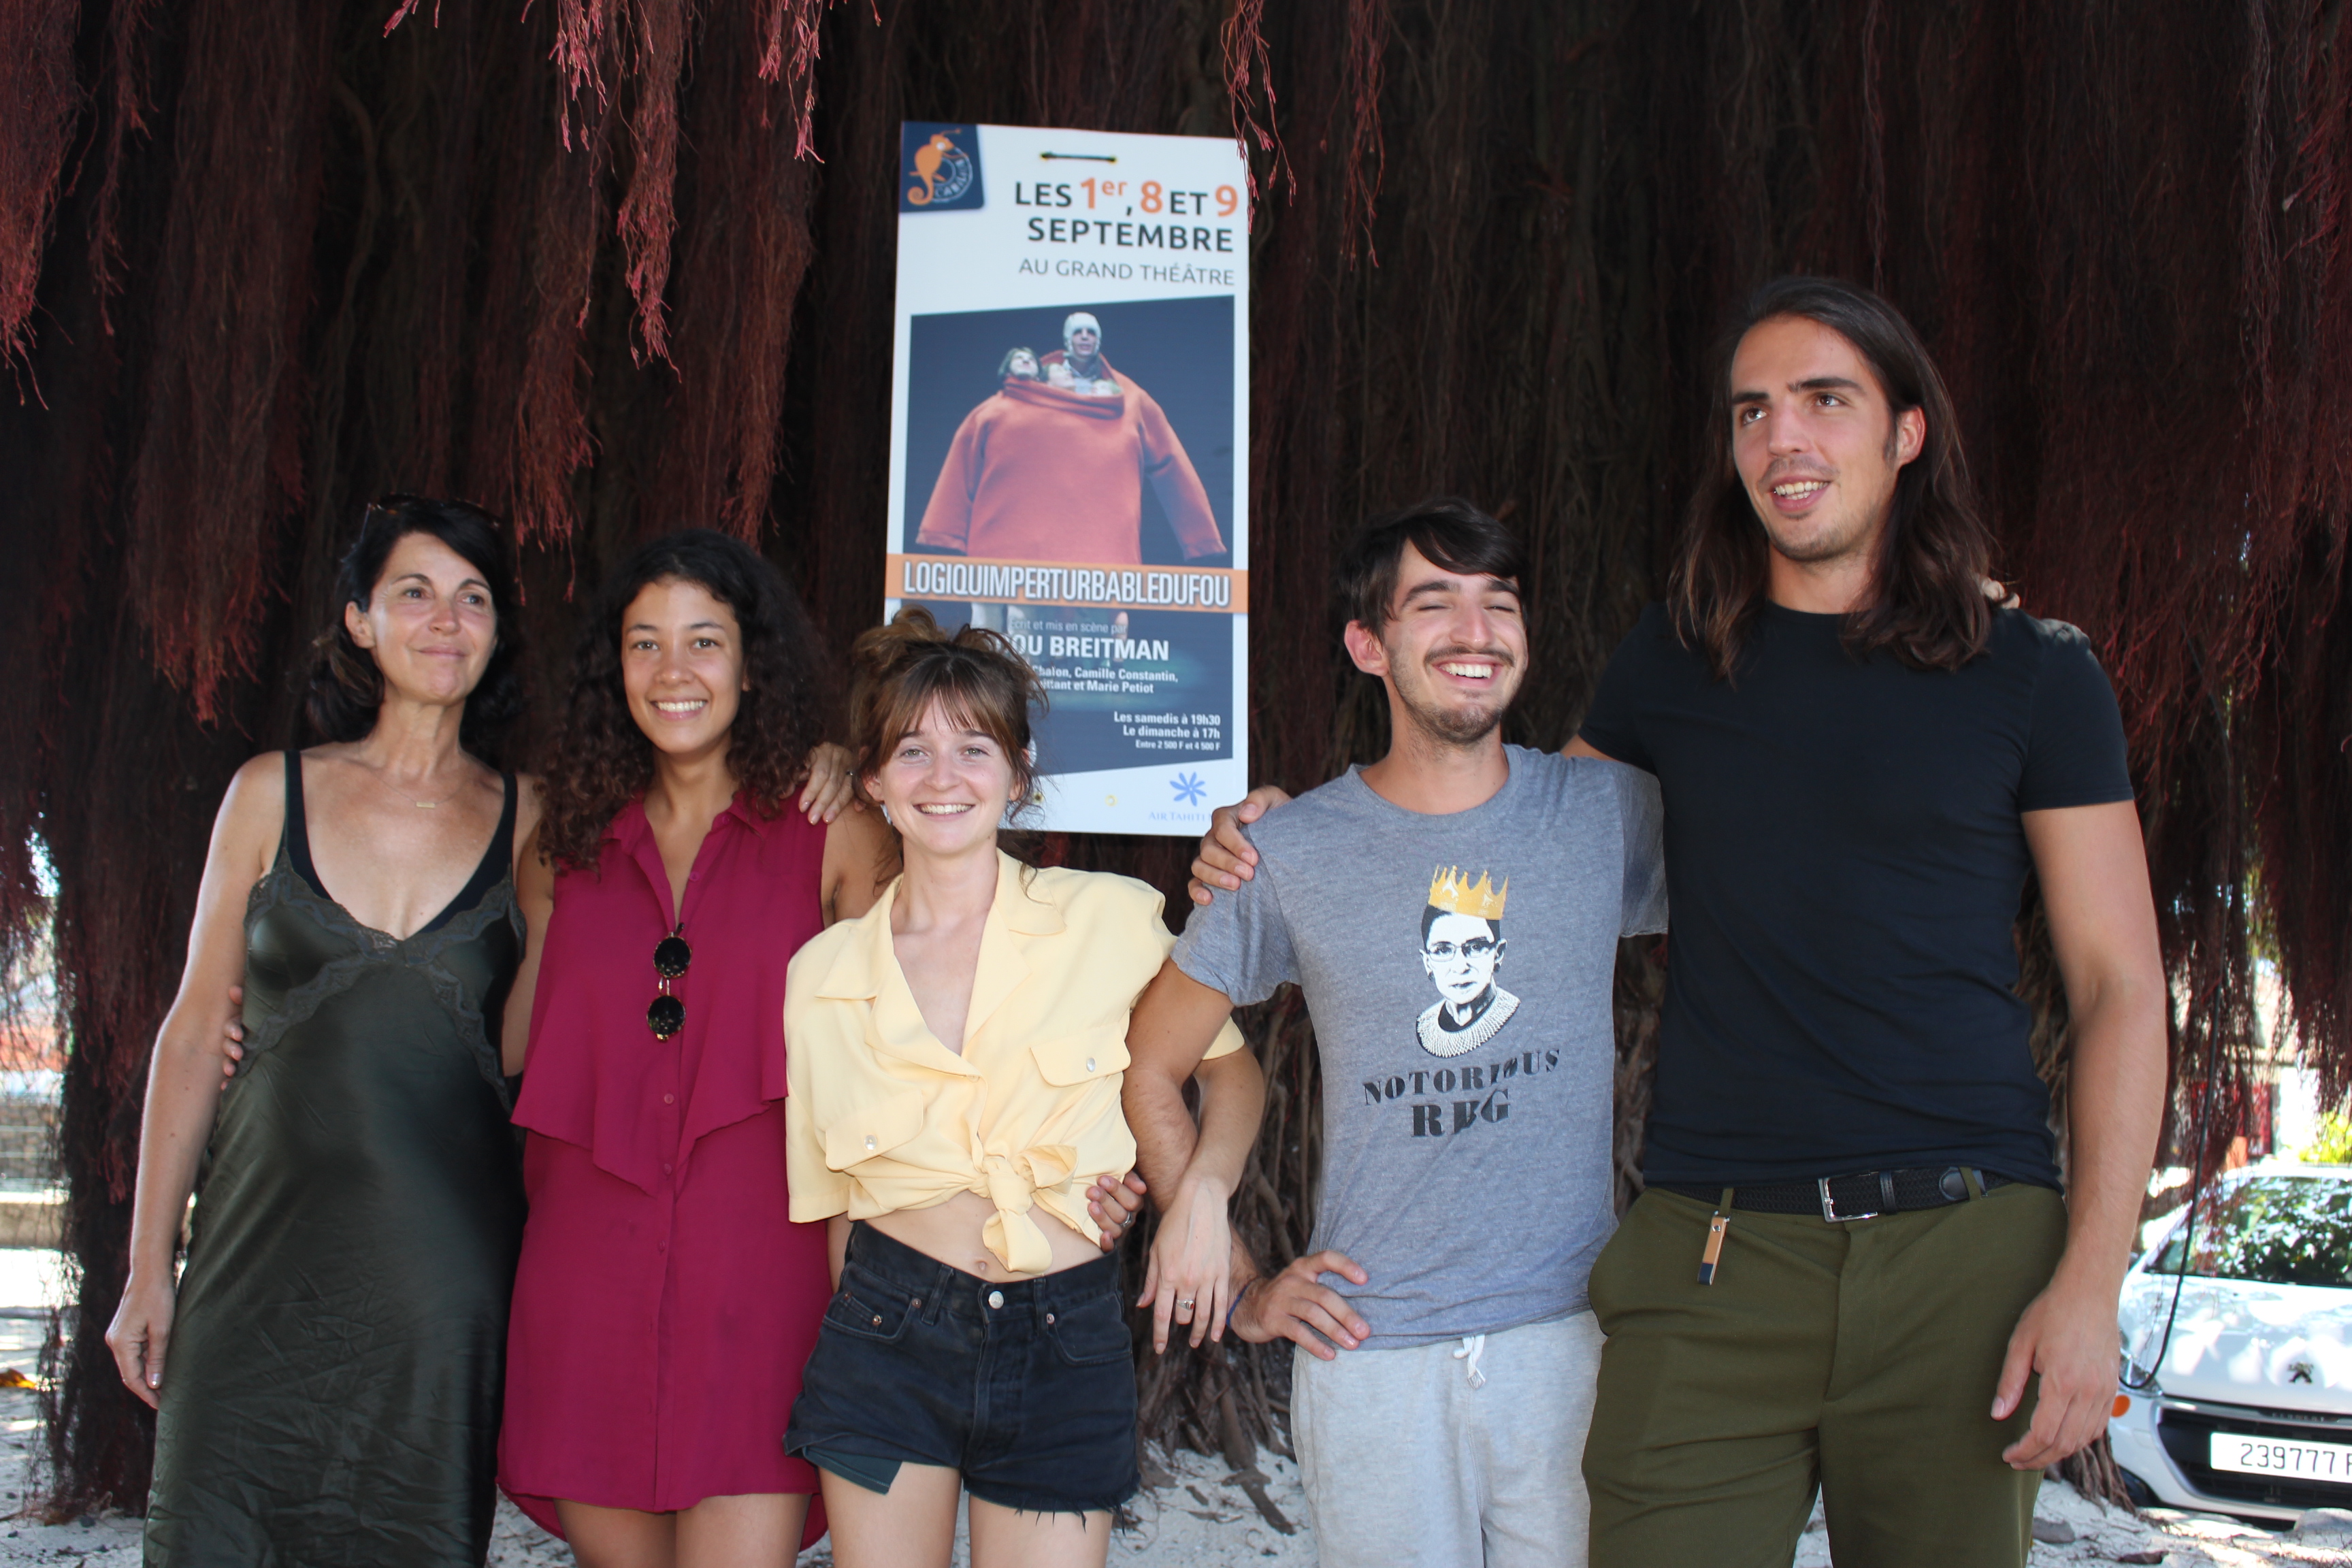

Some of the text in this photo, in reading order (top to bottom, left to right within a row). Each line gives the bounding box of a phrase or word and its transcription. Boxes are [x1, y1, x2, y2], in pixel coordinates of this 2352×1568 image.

[1015, 182, 1072, 207] LES
[1140, 180, 1164, 214] 8
[1170, 191, 1208, 215] ET
[1215, 184, 1239, 217] 9
[1028, 217, 1234, 252] SEPTEMBRE
[1018, 259, 1235, 286] AU GRAND THÉÂTRE
[904, 561, 1229, 606] LOGIQUIMPERTURBABLEDUFOU
[1032, 620, 1044, 631] et
[1045, 621, 1064, 632] mis
[1065, 623, 1078, 632] en
[1080, 621, 1109, 634] scène
[1111, 624, 1128, 636] par
[1049, 636, 1169, 662] BREITMAN
[1073, 681, 1085, 691] et
[1086, 681, 1120, 693] Marie
[1122, 681, 1155, 694] Petiot
[1074, 666, 1115, 680] Camille
[1118, 668, 1179, 683] Constantin,
[1113, 710, 1221, 726] Les samedis à 19h30
[1123, 724, 1221, 739] Le dimanche à 17h
[1135, 739, 1156, 749] Entre
[1157, 740, 1162, 749] 2
[1186, 742, 1193, 750] et
[1362, 1049, 1561, 1106] NOTORIOUS
[2241, 1443, 2336, 1474] 239777
